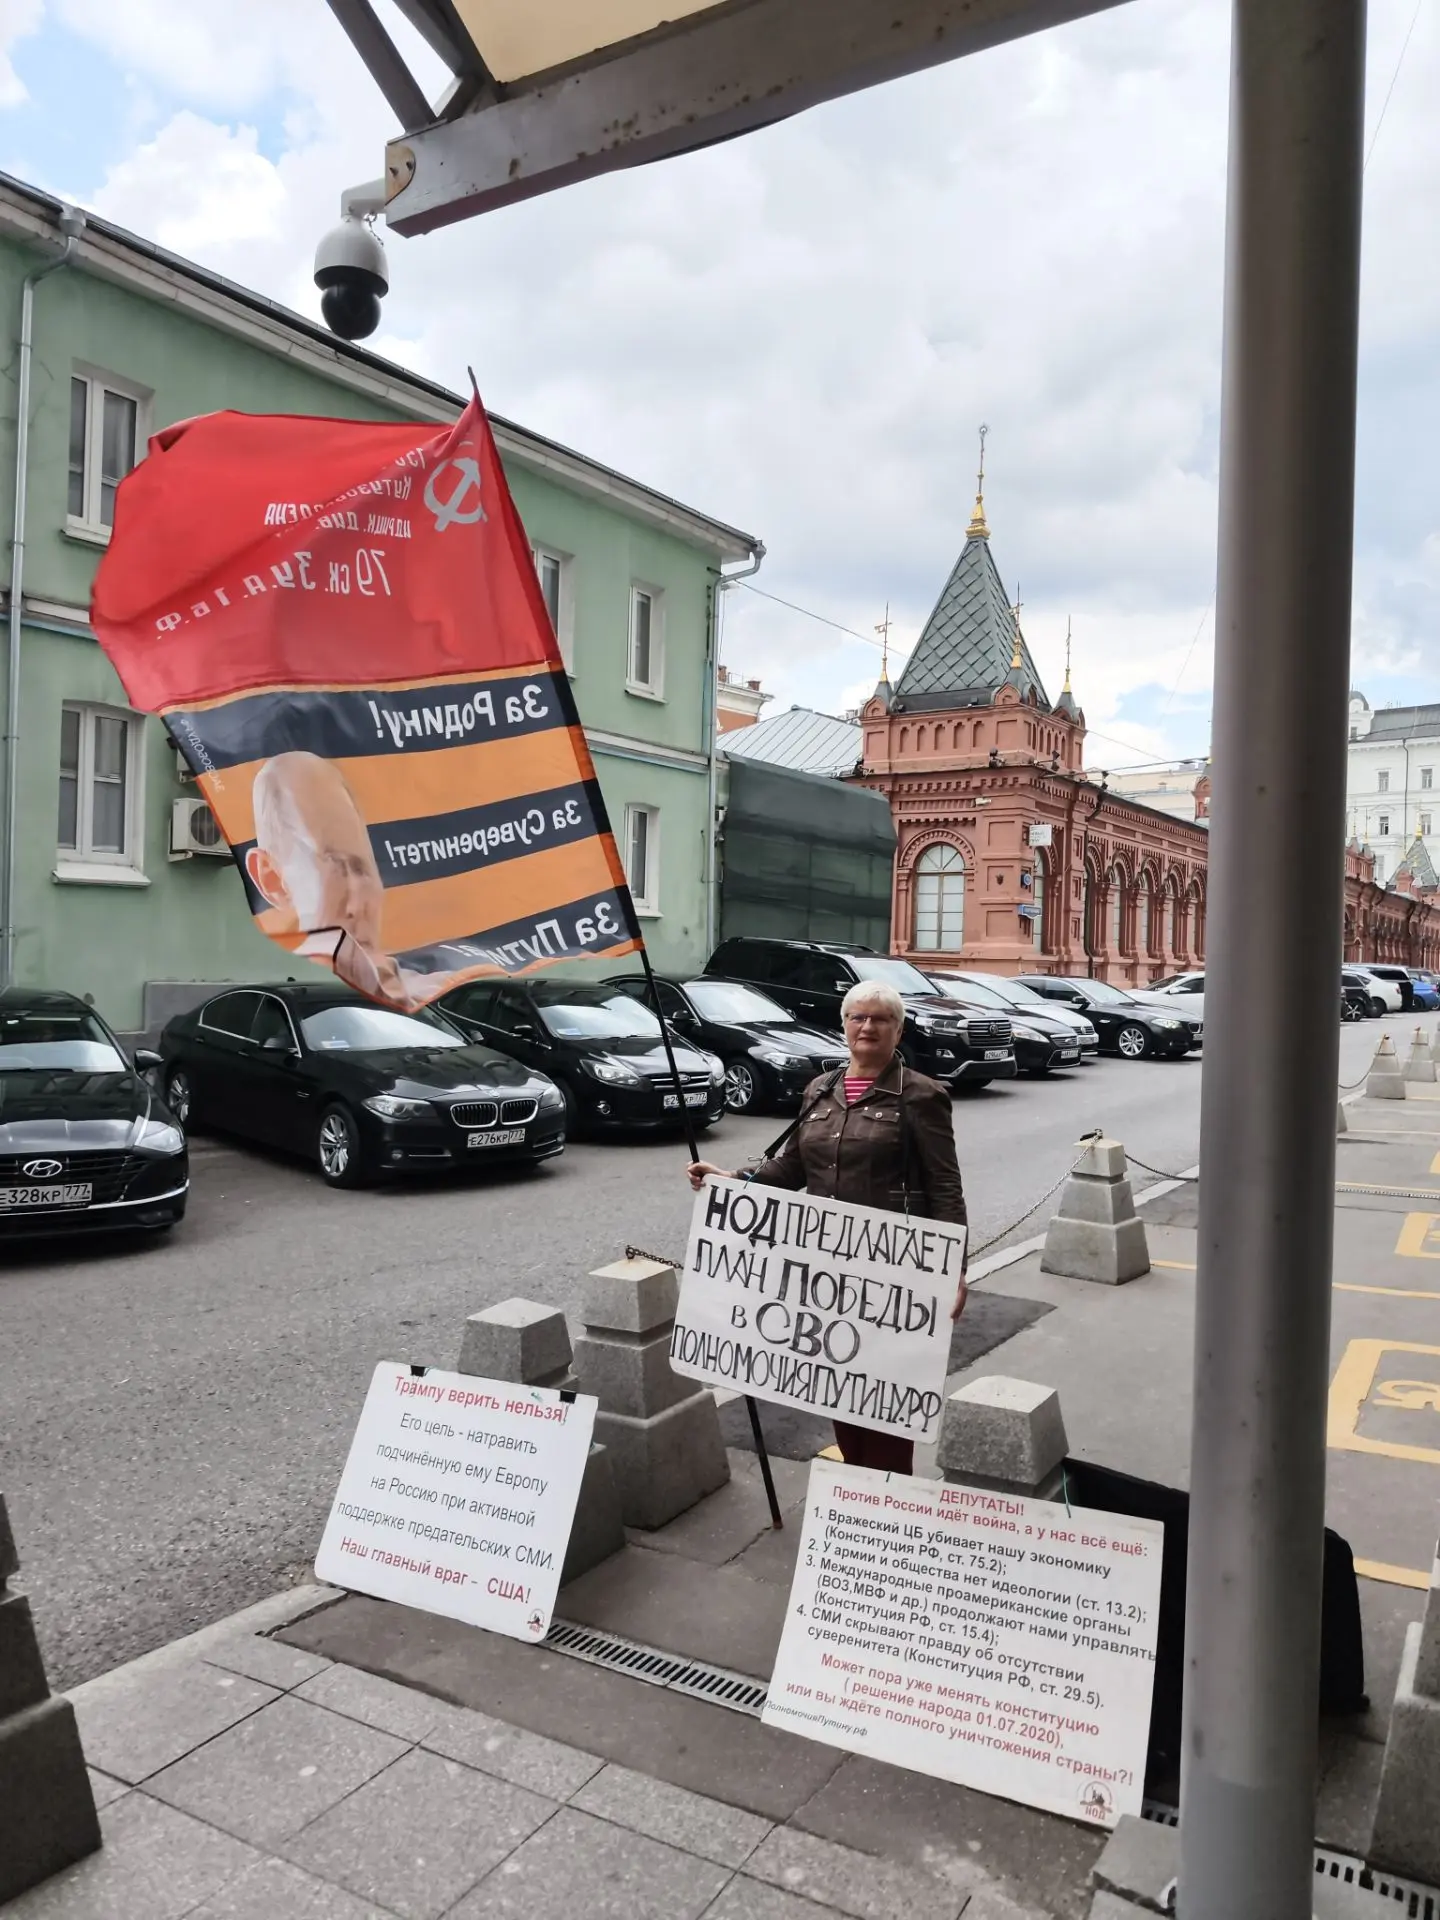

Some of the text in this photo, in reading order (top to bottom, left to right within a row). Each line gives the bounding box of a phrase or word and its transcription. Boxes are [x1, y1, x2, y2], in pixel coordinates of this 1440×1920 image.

[65, 1184, 88, 1197] 777
[705, 1184, 961, 1275] НОД ПРЕДЛАГАЕТ
[693, 1238, 938, 1337] ПЛАН ПОБЕДЫ
[755, 1302, 861, 1364] СВО
[395, 1376, 568, 1425] Трампу верить нельзя!
[400, 1412, 422, 1431] Его
[424, 1421, 455, 1437] цель
[466, 1429, 538, 1454] натравить
[370, 1476, 536, 1527] на Россию при активной
[376, 1444, 548, 1497] подчинённую ему Европу
[939, 1489, 1025, 1516] ДЕПУТАТЫ!
[337, 1502, 554, 1571] поддержке предательских СМИ.
[814, 1506, 1111, 1580] 1. Вражеский ЦБ убивает нашу экономику
[825, 1524, 1007, 1576] (Конституция РФ, ст. 75.2);
[833, 1485, 1147, 1557] Против России идёт война, а у нас всё ещё:
[340, 1536, 369, 1558] Наш
[371, 1549, 431, 1576] главный
[434, 1566, 469, 1585] враг
[487, 1577, 531, 1604] США!
[805, 1554, 1131, 1637] 3. Международные проамериканские органы
[808, 1538, 1147, 1623] 2. У армии и общества нет идеологии (ст. 13.2);
[796, 1604, 1084, 1683] 4. СМИ скрывают правду об отсутствии
[814, 1590, 999, 1647] (Конституция РФ, ст. 15.4);
[889, 1593, 898, 1603] и
[900, 1596, 928, 1613] др.)
[932, 1602, 1025, 1632] продолжают
[1029, 1624, 1068, 1642] нами
[807, 1626, 1104, 1710] суверенитета (Конституция РФ, ст. 29.5).
[821, 1653, 1099, 1736] Может пора уже менять конституцию
[786, 1683, 1132, 1786] или вы ждёте полного уничтожения страны?!
[852, 1682, 914, 1707] решение
[918, 1699, 971, 1722] народа
[976, 1712, 1063, 1749] 01.07.2020),
